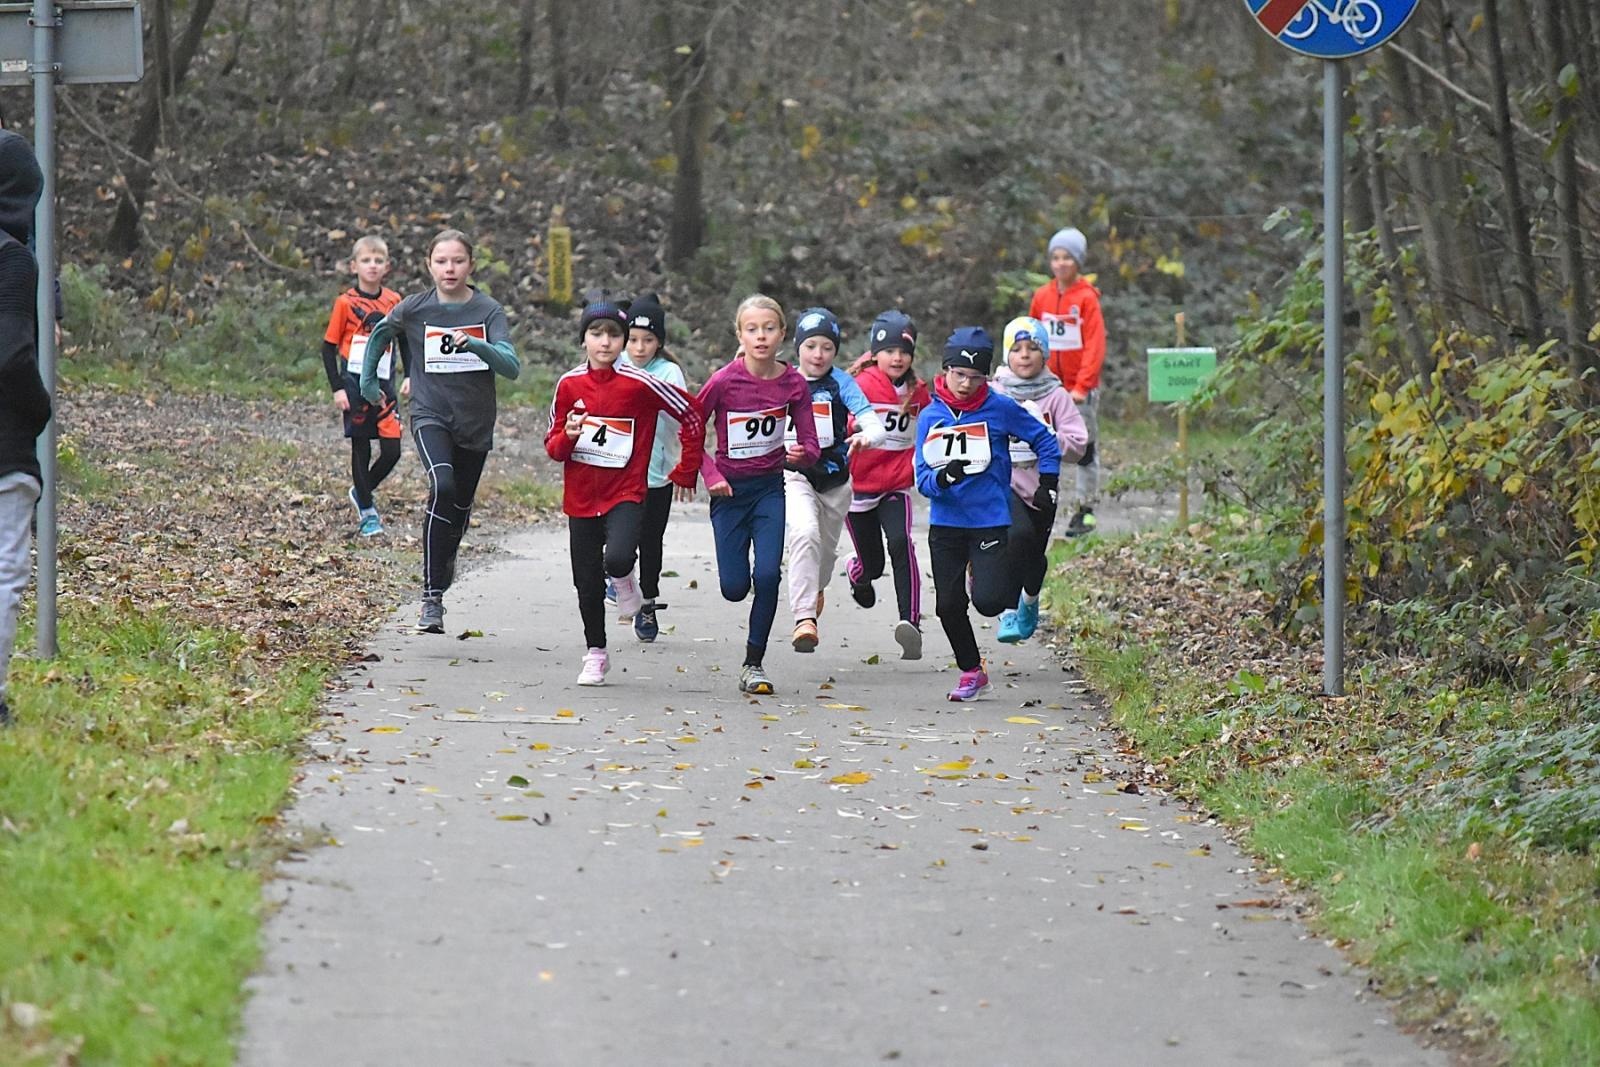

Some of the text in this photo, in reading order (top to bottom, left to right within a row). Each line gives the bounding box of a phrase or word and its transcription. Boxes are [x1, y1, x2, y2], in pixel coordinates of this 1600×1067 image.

[1050, 320, 1065, 336] 18
[745, 415, 777, 440] 90
[885, 410, 910, 432] 50
[592, 424, 607, 446] 4
[943, 432, 967, 457] 71
